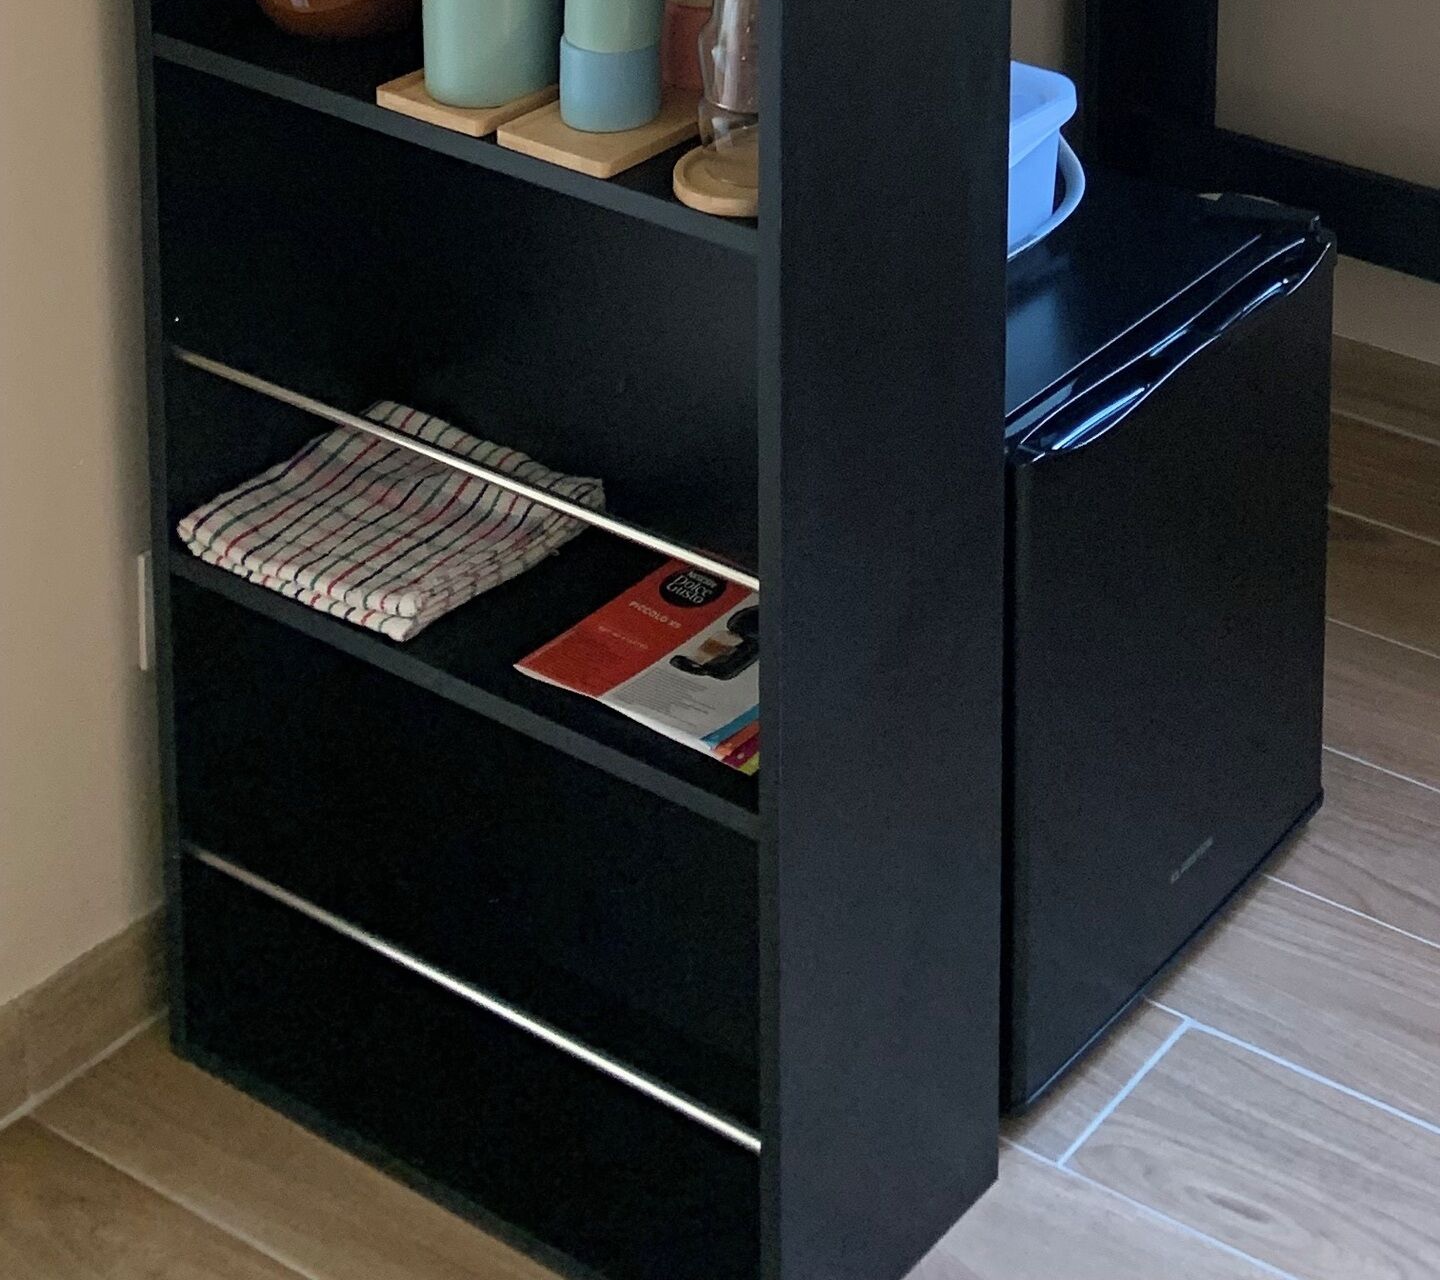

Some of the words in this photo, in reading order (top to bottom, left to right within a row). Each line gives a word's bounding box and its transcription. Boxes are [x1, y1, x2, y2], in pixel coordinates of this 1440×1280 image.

[665, 581, 705, 604] Gusto
[673, 574, 713, 598] Dolce
[629, 601, 668, 623] PICCOLO
